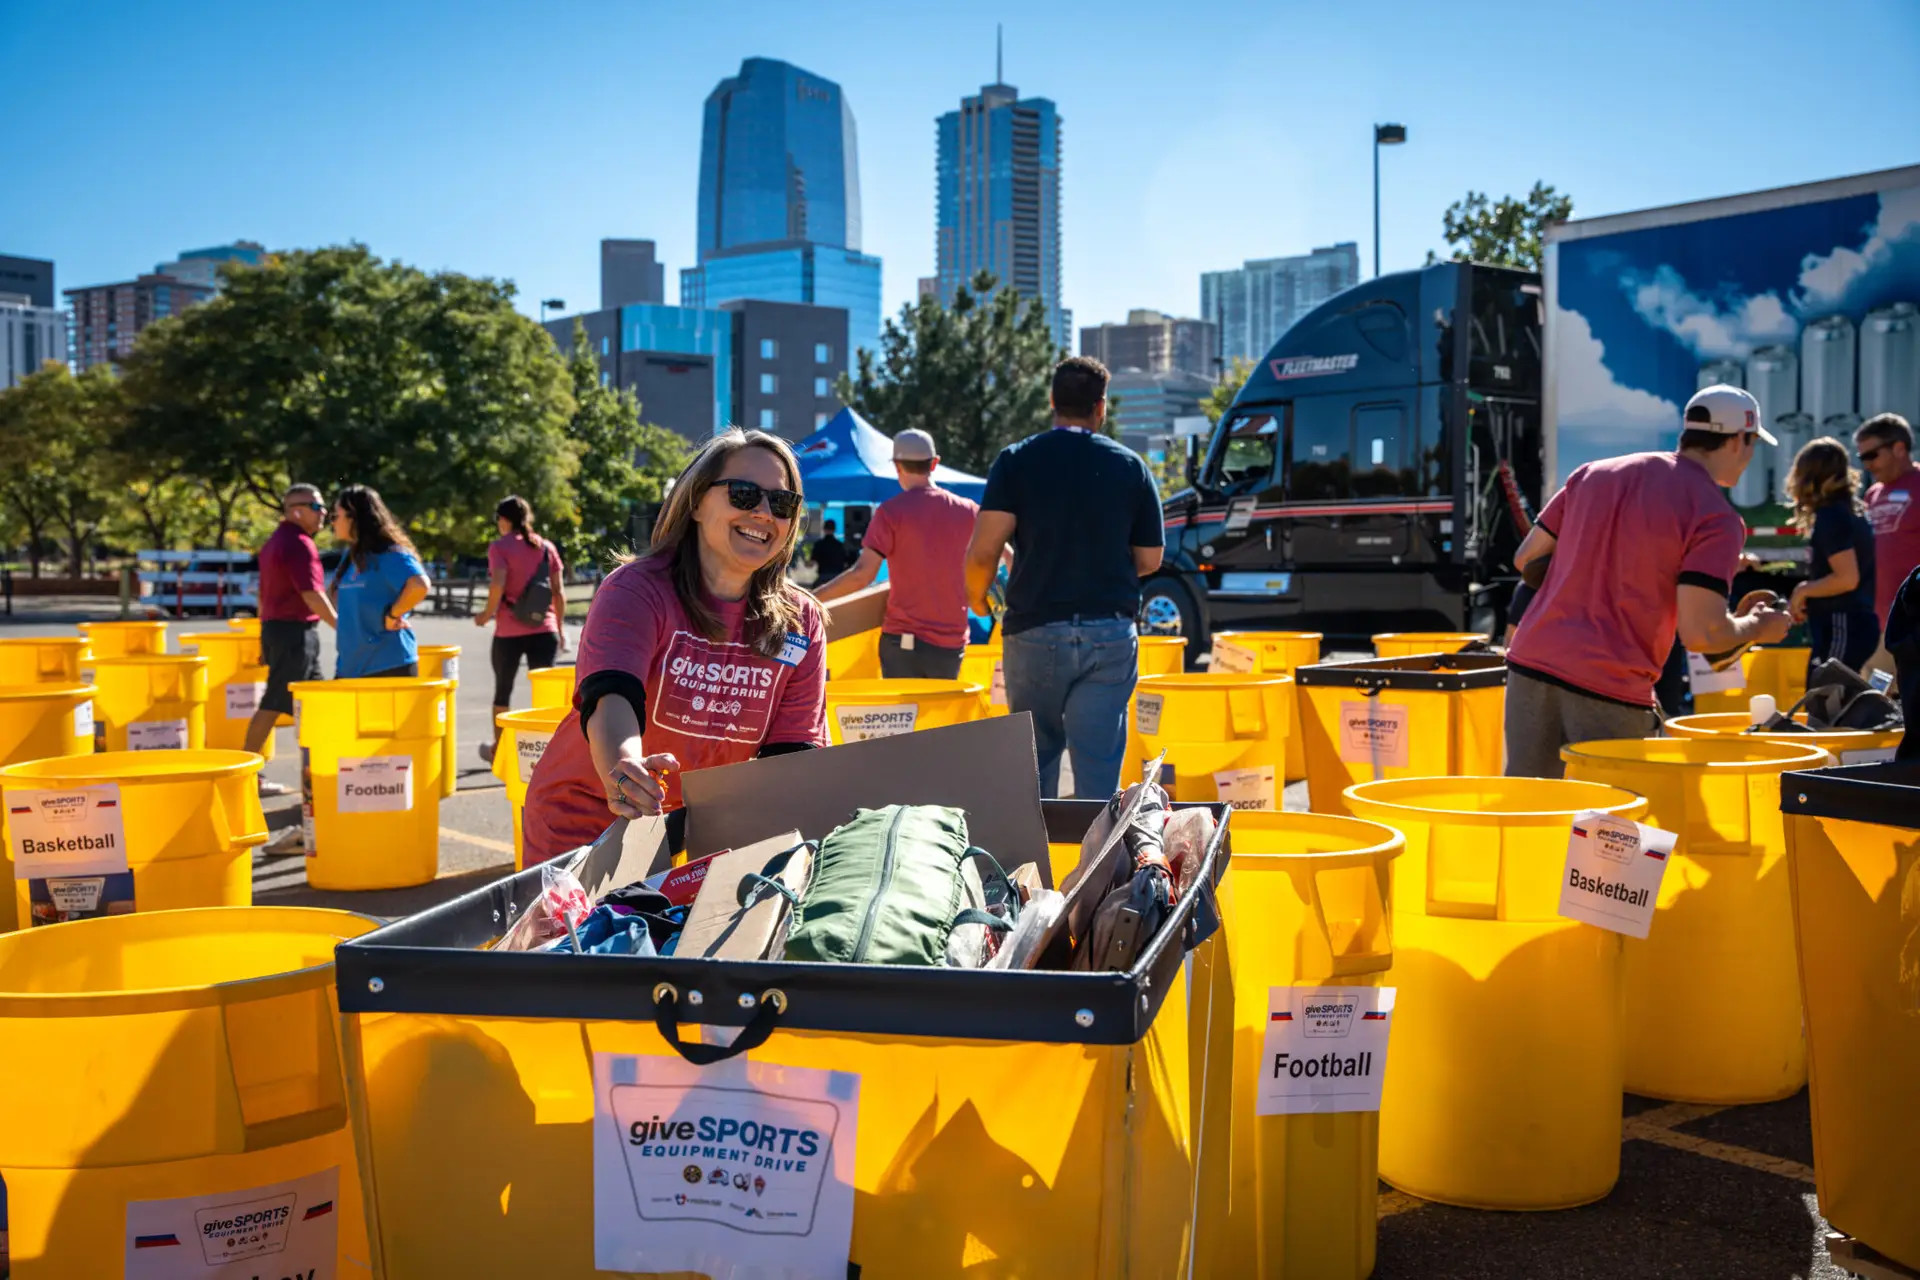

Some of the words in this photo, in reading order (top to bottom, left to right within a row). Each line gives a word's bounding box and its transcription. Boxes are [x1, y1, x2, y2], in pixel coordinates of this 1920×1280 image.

[669, 656, 773, 687] giveSORTS
[674, 676, 729, 694] QUIPMT
[730, 687, 767, 699] DRIVE
[841, 712, 913, 725] giveSPORTS
[345, 782, 404, 796] Football
[22, 833, 115, 854] Basketball
[670, 874, 690, 887] BALLS
[691, 867, 707, 879] GOLF
[1569, 868, 1649, 908] Basketball
[1305, 1004, 1353, 1015] giveSPORTS
[1273, 1052, 1372, 1079] Football
[629, 1115, 820, 1157] giveSPORTS
[642, 1145, 750, 1164] EQUIPMENT
[754, 1154, 808, 1173] DRIVE
[203, 1206, 290, 1235] giveSPORTS
[208, 1225, 259, 1239] EQUIPMENT
[261, 1219, 285, 1230] DRIVE
